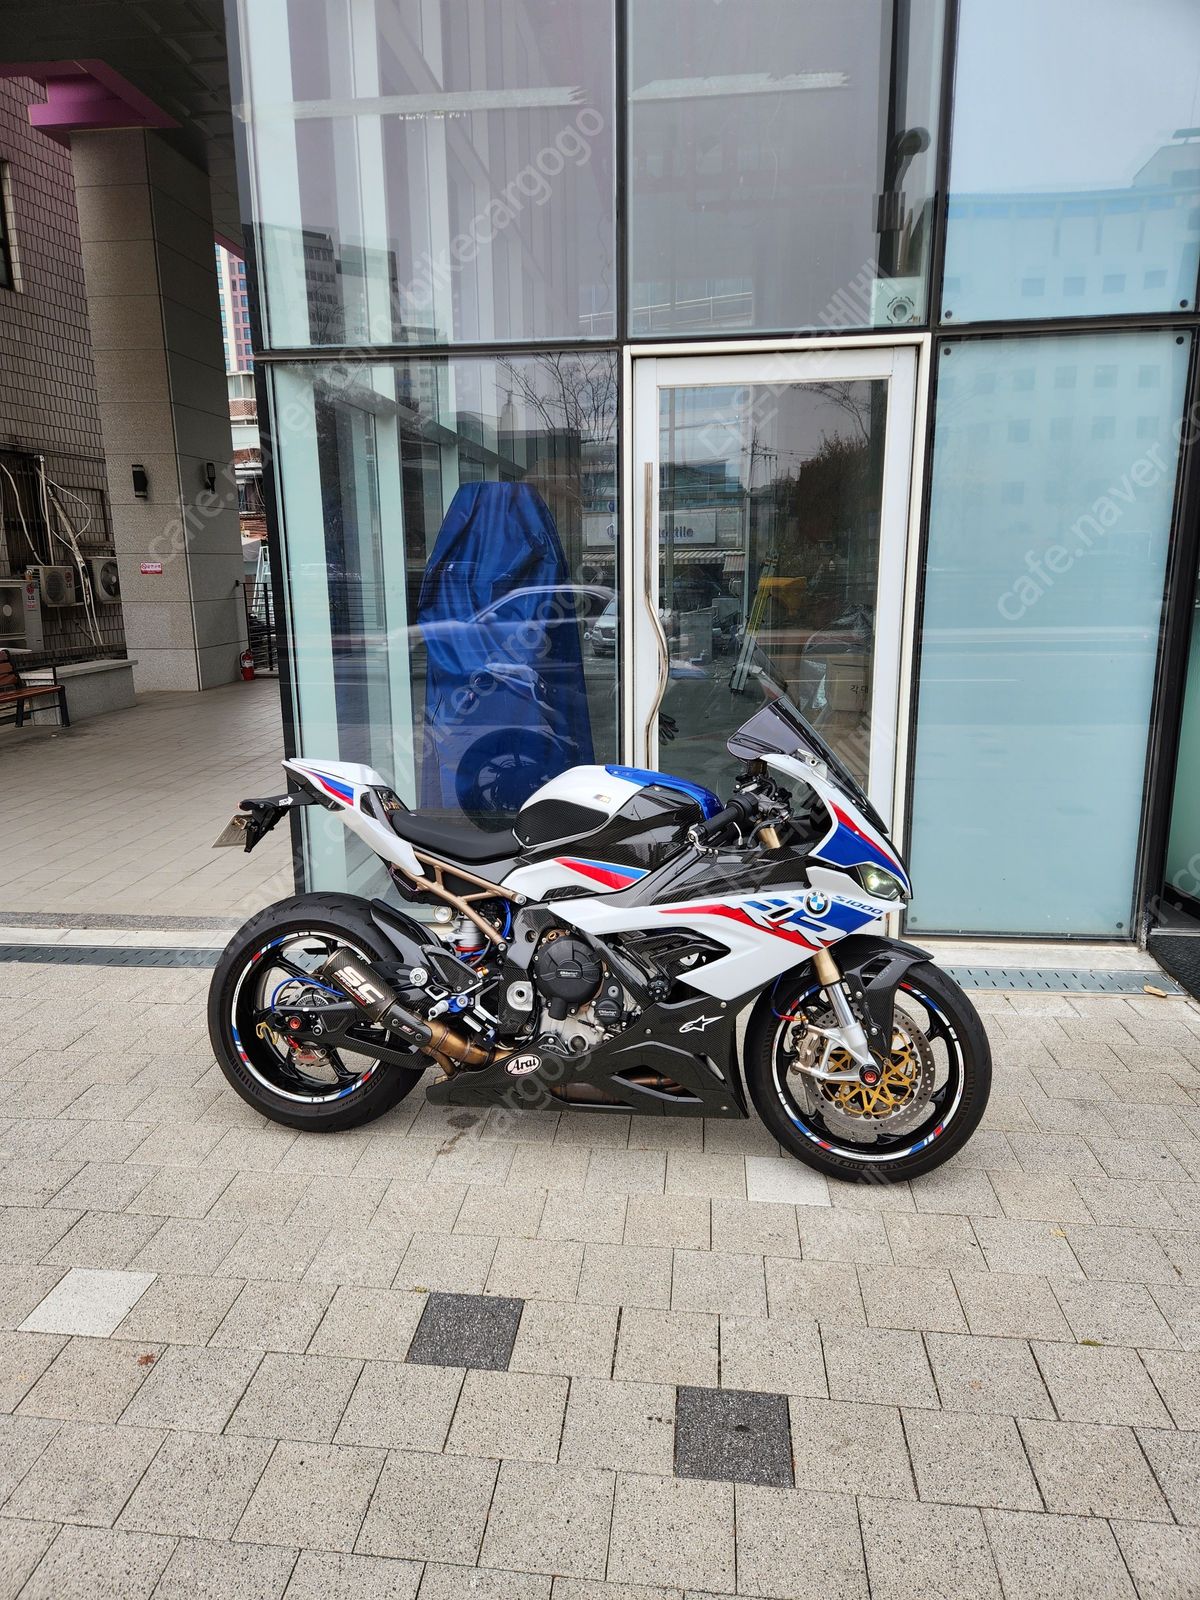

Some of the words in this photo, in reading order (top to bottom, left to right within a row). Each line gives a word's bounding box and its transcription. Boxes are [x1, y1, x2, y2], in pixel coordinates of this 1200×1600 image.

[832, 895, 884, 915] S1000
[336, 964, 385, 1003] SC
[509, 1056, 537, 1074] Arai
